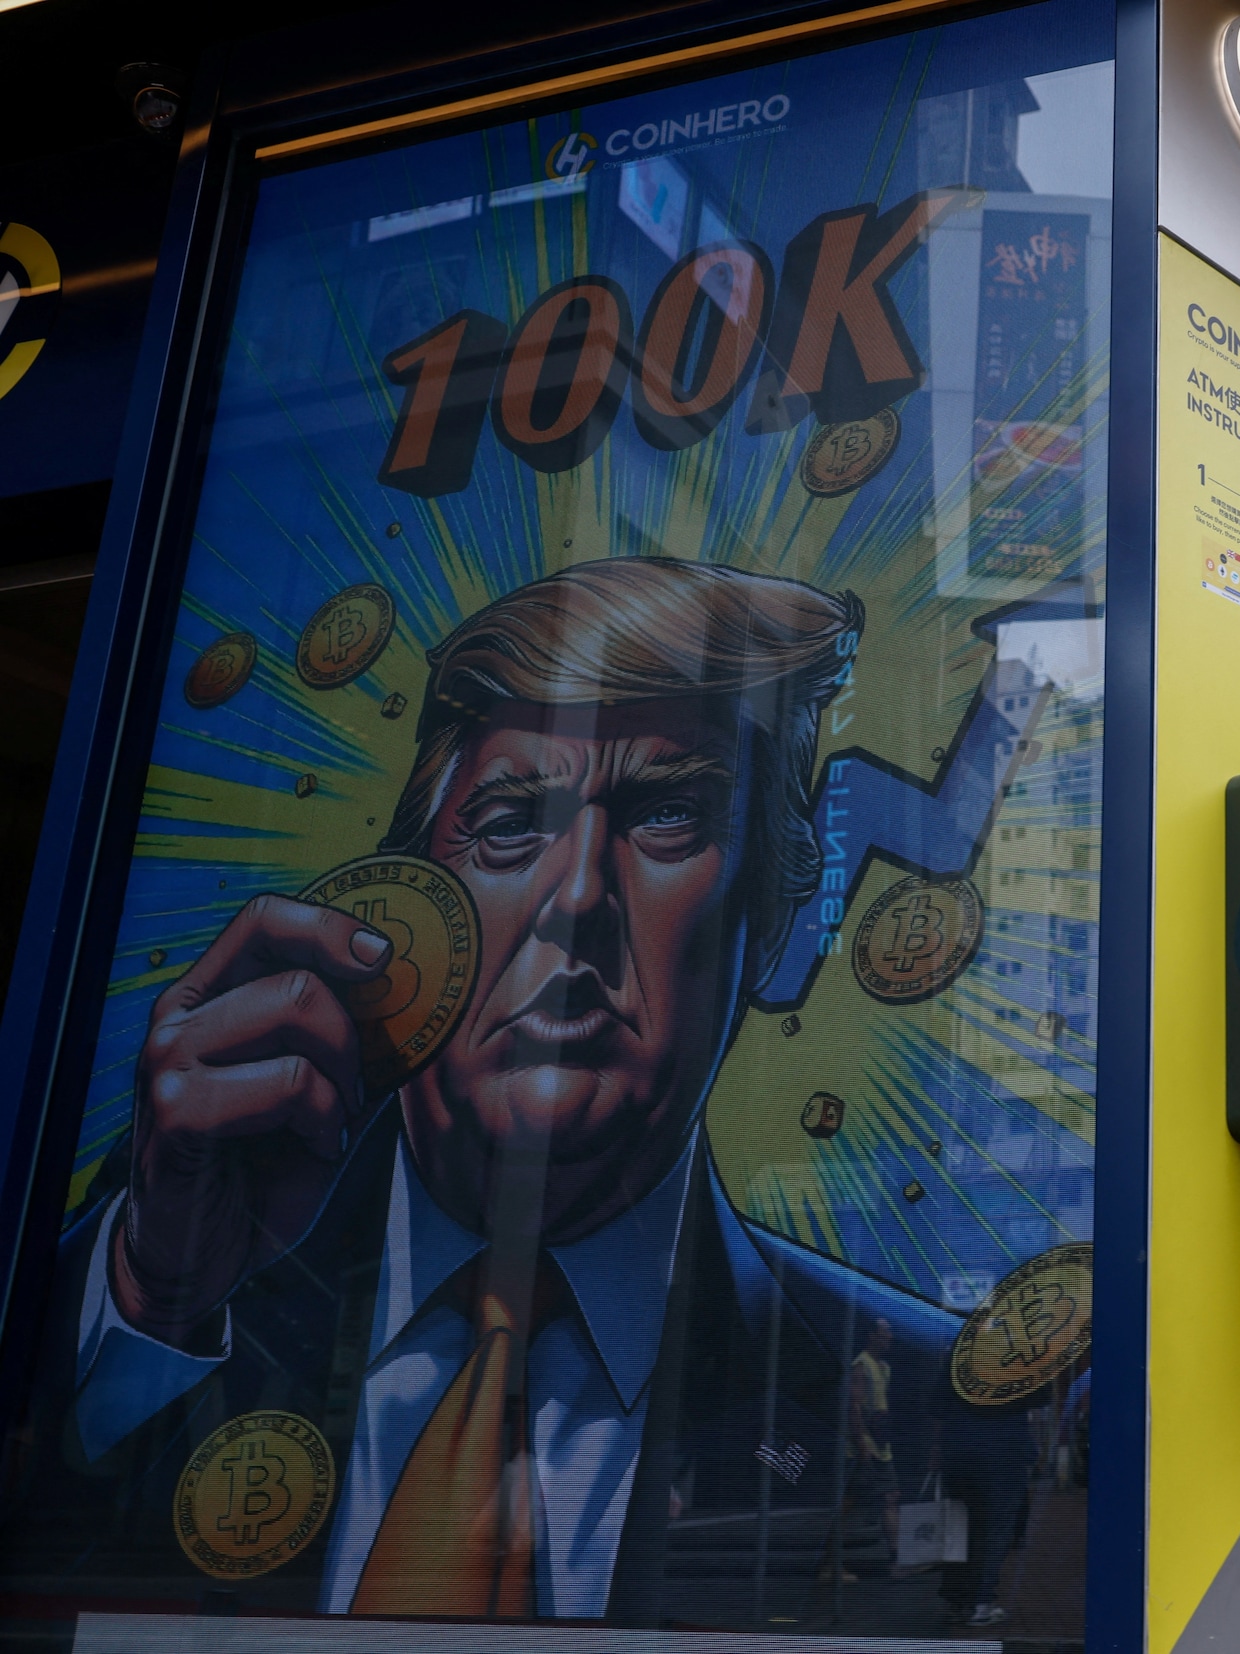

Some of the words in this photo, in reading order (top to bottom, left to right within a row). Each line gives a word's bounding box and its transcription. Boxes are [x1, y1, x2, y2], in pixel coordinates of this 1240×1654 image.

[605, 94, 790, 156] COINHERO
[380, 186, 985, 494] 100K
[1187, 330, 1208, 349] Crypto
[1209, 343, 1215, 352] is
[1216, 348, 1229, 362] your
[1197, 464, 1205, 486] 1
[1193, 505, 1213, 520] Choose
[1214, 516, 1222, 525] the
[1196, 515, 1205, 524] like
[1212, 524, 1223, 535] buy,
[1224, 530, 1236, 540] then
